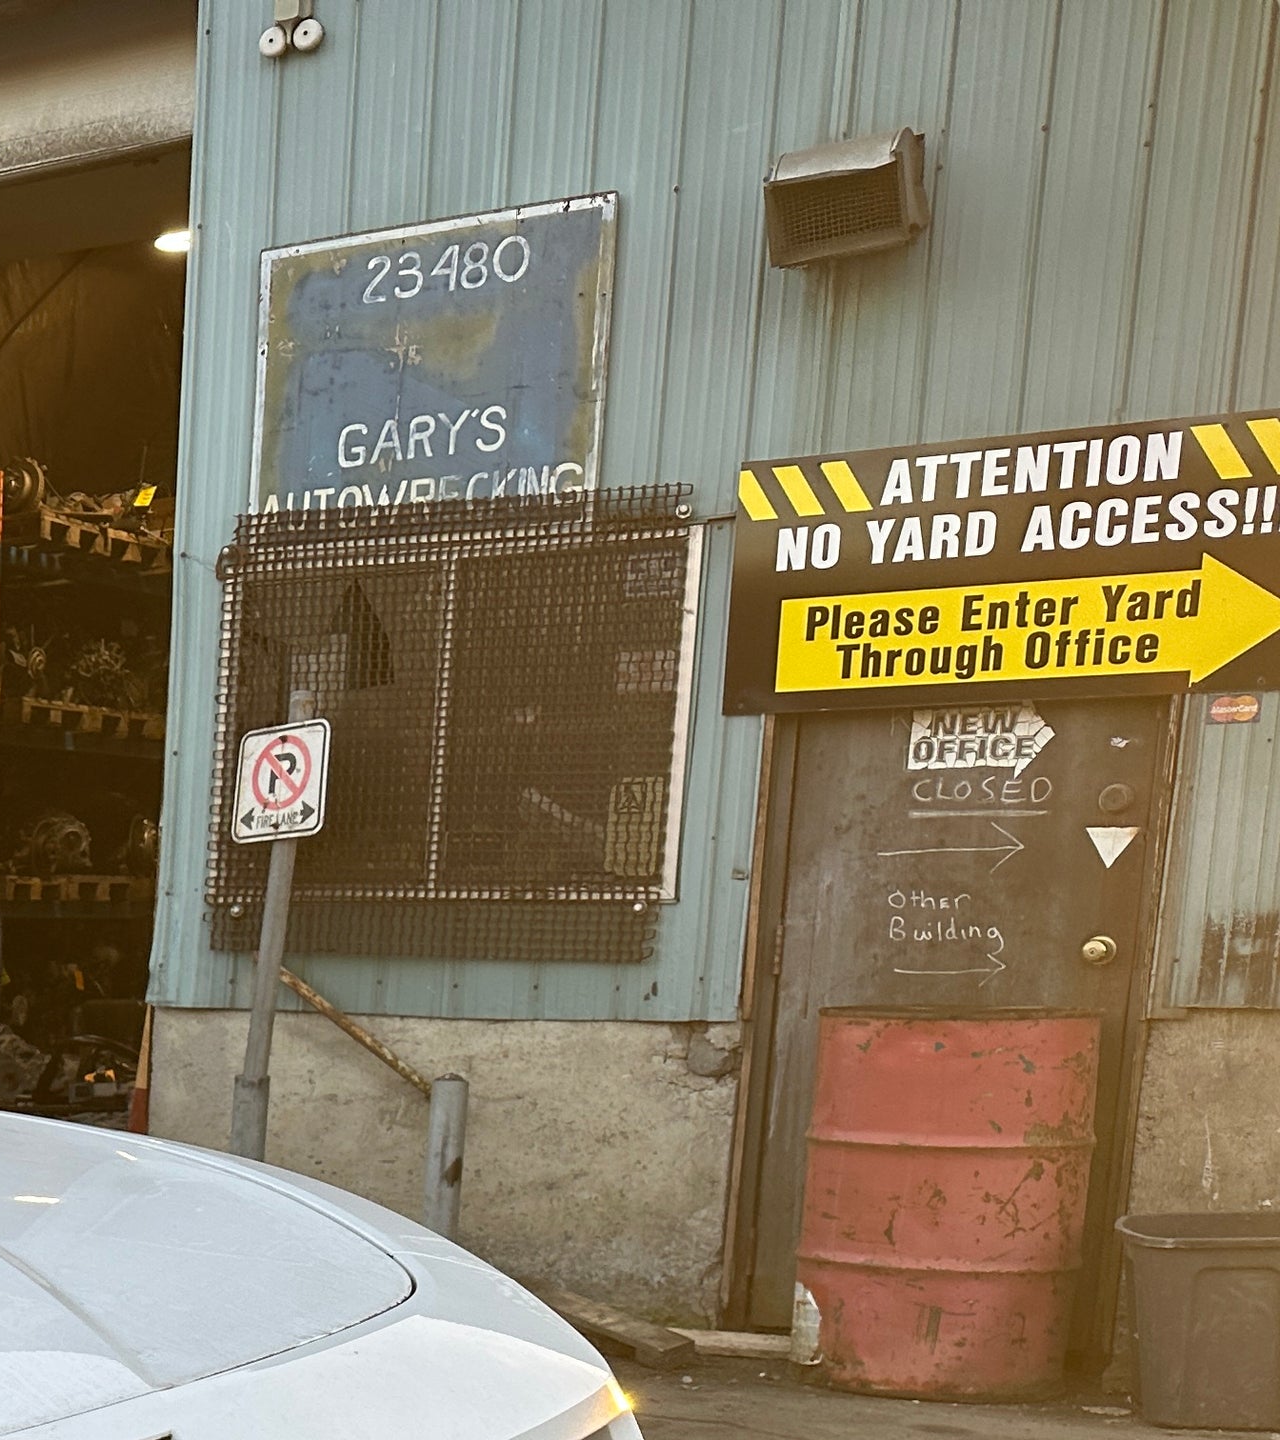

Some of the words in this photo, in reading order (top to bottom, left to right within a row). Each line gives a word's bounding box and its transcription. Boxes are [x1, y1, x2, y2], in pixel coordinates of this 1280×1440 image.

[362, 236, 531, 304] 23480
[337, 405, 508, 469] GARY'S
[879, 430, 1184, 506] ATTENTION
[774, 523, 841, 572] NO
[866, 510, 998, 565] YARD
[1020, 485, 1280, 553] ACCESS!!
[804, 603, 940, 642] Please
[961, 594, 1079, 632] Enter
[1101, 578, 1203, 623] Yard
[836, 635, 1004, 681] Through
[1023, 630, 1161, 670] Office
[931, 709, 1019, 737] NEW
[912, 735, 1037, 764] OFFICE
[911, 776, 1053, 803] CLOSED
[255, 813, 275, 830] FIRE
[889, 916, 1005, 954] Building
